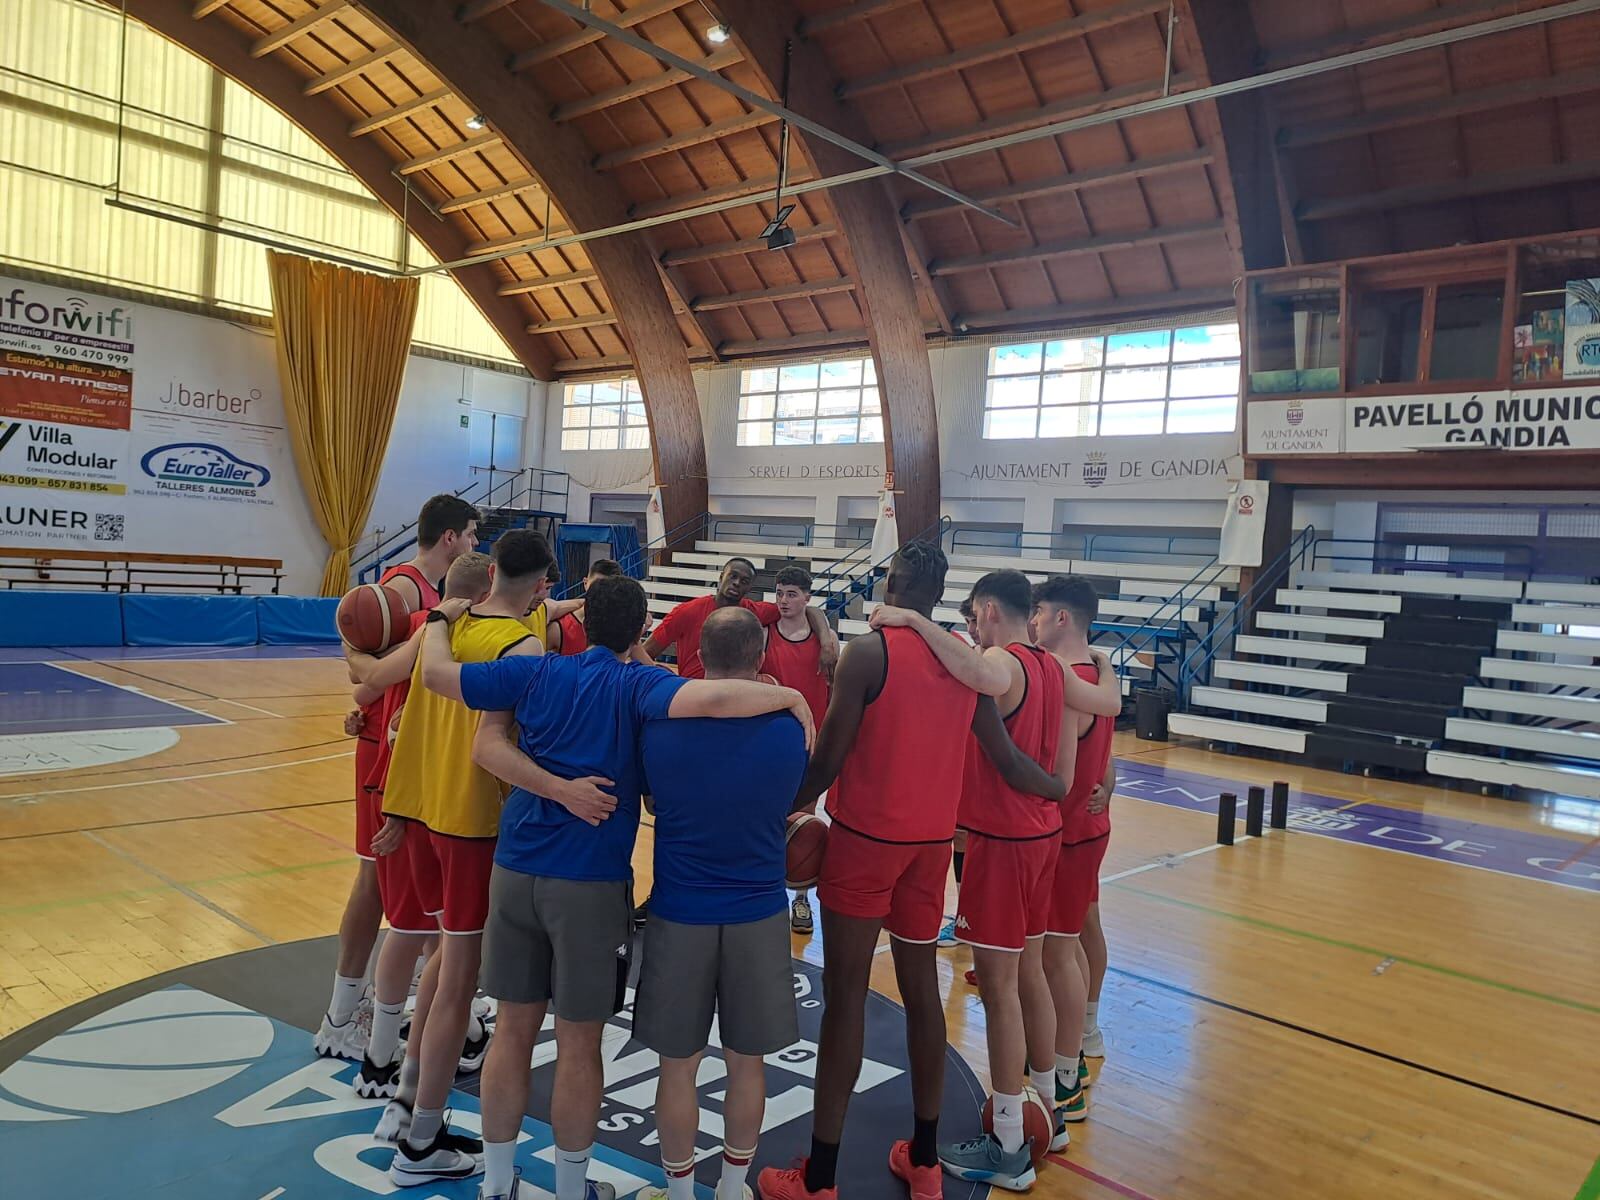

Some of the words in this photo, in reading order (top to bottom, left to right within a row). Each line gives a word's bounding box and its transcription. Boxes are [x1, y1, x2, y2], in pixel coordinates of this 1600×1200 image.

[0, 289, 132, 339] forwifi
[53, 344, 77, 357] 960
[80, 348, 104, 361] 470
[106, 352, 129, 365] 999
[1353, 395, 1484, 427] PAVELLÓ
[28, 424, 73, 446] Villa
[1260, 428, 1329, 439] AJUNTAMENT
[1266, 440, 1279, 450] DE
[1281, 439, 1324, 450] GANDIA
[1444, 425, 1571, 448] GANDIA
[27, 445, 118, 470] Modular
[0, 474, 15, 484] 43
[17, 475, 38, 486] 099
[163, 457, 253, 481] EuroTaller
[749, 464, 791, 478] SERVEI
[969, 462, 1072, 479] AJUNTAMENT
[1119, 461, 1143, 477] DE
[1150, 459, 1229, 477] GANDIA
[155, 480, 205, 493] TALLERES
[208, 485, 257, 498] ALMOINES
[0, 505, 89, 530] UNER
[1367, 825, 1497, 858] DE
